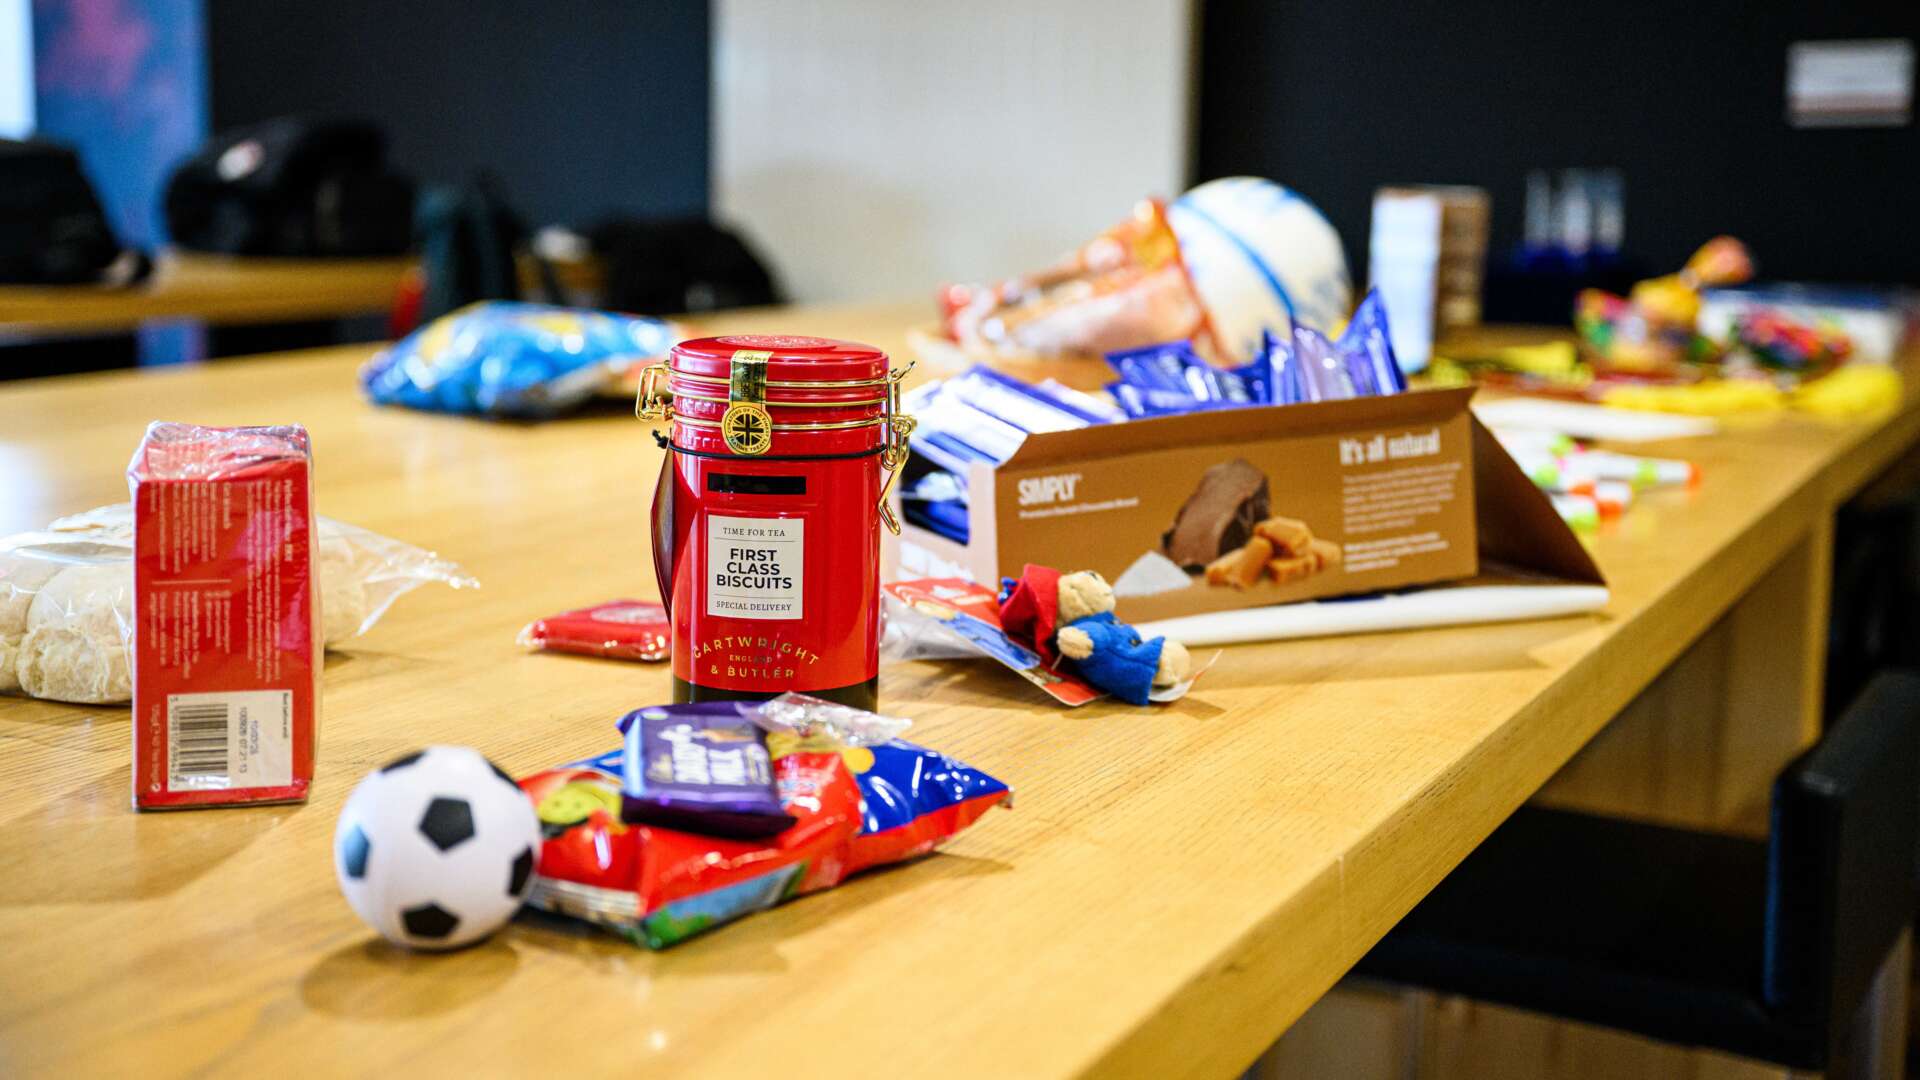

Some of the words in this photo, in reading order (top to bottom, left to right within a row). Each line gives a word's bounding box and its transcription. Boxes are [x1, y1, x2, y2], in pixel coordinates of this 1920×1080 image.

[1340, 437, 1364, 465] It's
[1366, 434, 1386, 462] all
[1388, 428, 1440, 459] natural
[1018, 474, 1079, 506] SIMPLY
[723, 527, 744, 536] TIME
[747, 528, 765, 536] FOR
[768, 529, 785, 537] TEA
[730, 548, 777, 562] FIRST
[726, 561, 780, 575] CLASS
[716, 574, 792, 589] BISCUITS
[716, 601, 748, 610] SPECIAL
[750, 603, 792, 611] DELIVERY
[693, 636, 819, 665] CARTWRIGHT
[711, 664, 718, 675] &
[727, 666, 794, 679] BUTLER
